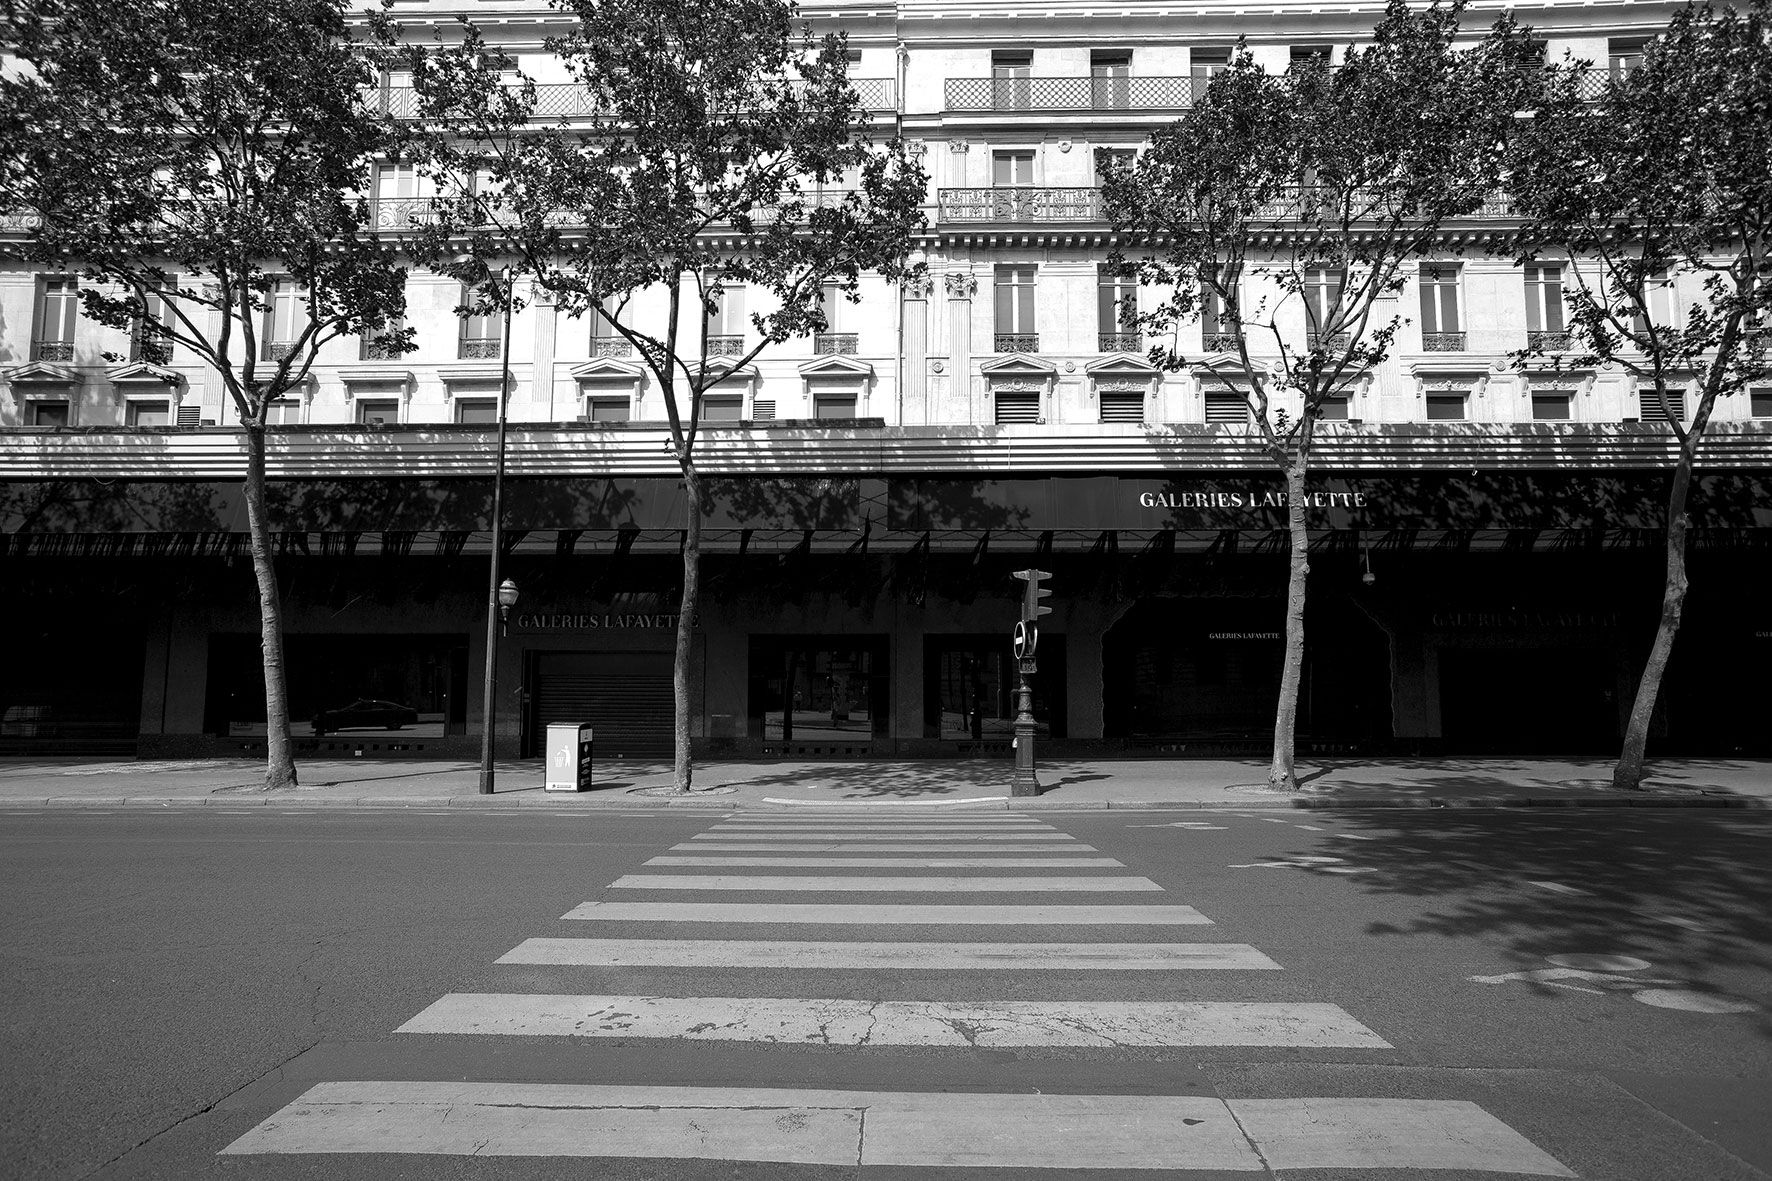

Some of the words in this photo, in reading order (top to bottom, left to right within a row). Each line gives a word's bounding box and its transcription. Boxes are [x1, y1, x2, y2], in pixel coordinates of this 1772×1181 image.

[1139, 492, 1243, 508] GALERIES
[1250, 492, 1368, 508] LAFYETTE
[518, 614, 600, 628] GALERIES
[604, 614, 700, 628] LAFAYETE
[1208, 631, 1242, 640] GALERIES
[1242, 631, 1281, 640] LAFAYETTE
